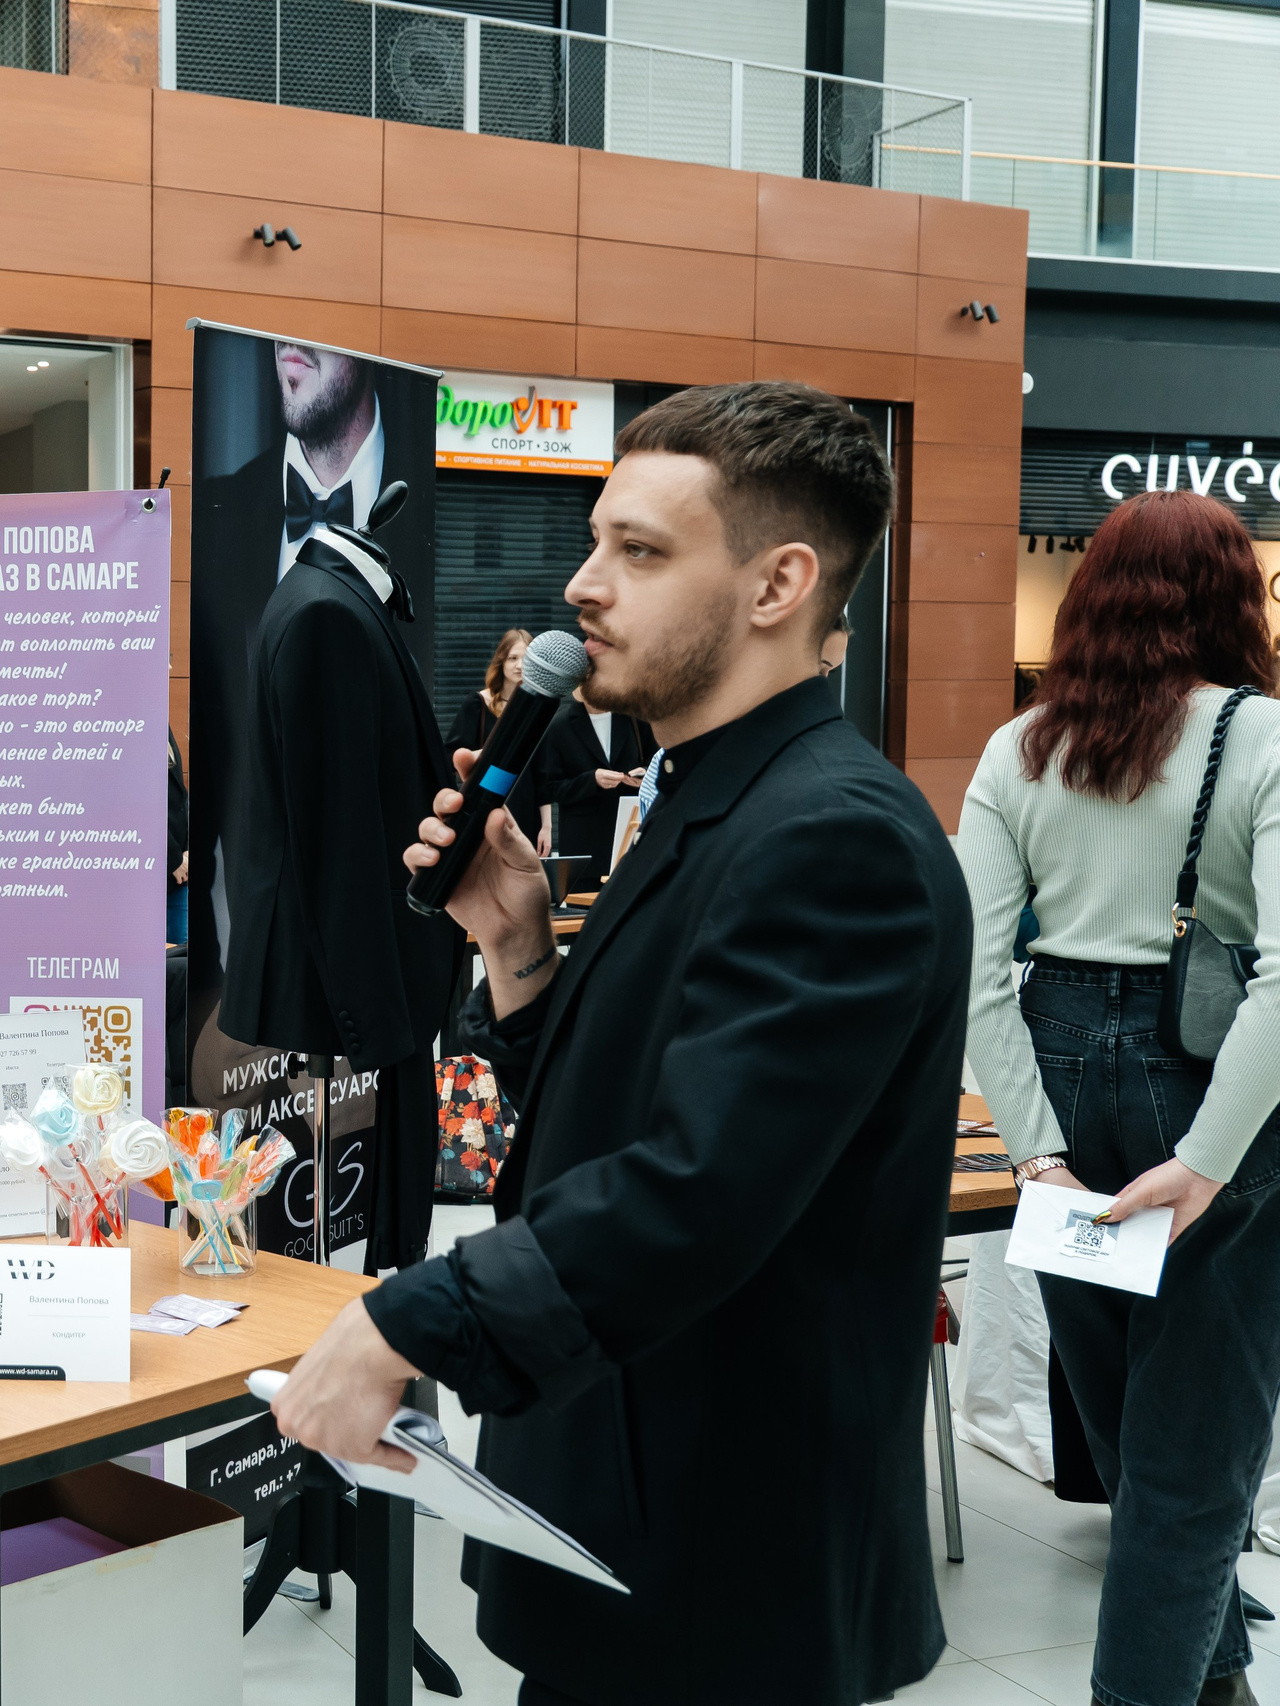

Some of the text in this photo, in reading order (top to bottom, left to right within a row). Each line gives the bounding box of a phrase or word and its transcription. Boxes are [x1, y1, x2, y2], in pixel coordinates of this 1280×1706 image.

[491, 437, 572, 453] СПОРТ ЗОЖ
[1100, 441, 1280, 504] cuvé
[3, 525, 95, 554] ПОПОВА
[25, 562, 41, 591] В
[47, 560, 139, 591] САМАРЕ
[4, 611, 75, 626] человек,
[81, 604, 161, 627] который
[20, 638, 116, 652] воплотить
[121, 637, 155, 651] ваш
[42, 688, 103, 709] торт?
[33, 720, 68, 733] это
[72, 718, 145, 736] восторг
[51, 742, 109, 761] детей
[111, 748, 123, 760] и
[37, 796, 85, 815] быть
[44, 829, 55, 842] и
[58, 828, 143, 846] уютным,
[22, 851, 140, 873] грандиозным
[144, 856, 156, 870] и
[26, 956, 120, 980] ТЕЛЕГРАМ
[0, 1031, 40, 1041] Валентина
[41, 1029, 69, 1038] Попова
[223, 1051, 308, 1095] МУЖСК
[250, 1069, 380, 1130] И АКСЕСУАР
[284, 1234, 315, 1258] GOO
[6, 1259, 56, 1281] WD
[29, 1295, 109, 1305] Валентина Попова
[209, 1468, 222, 1488] Г.
[225, 1442, 278, 1479] Самара,
[254, 1462, 302, 1501] тел.: +7
